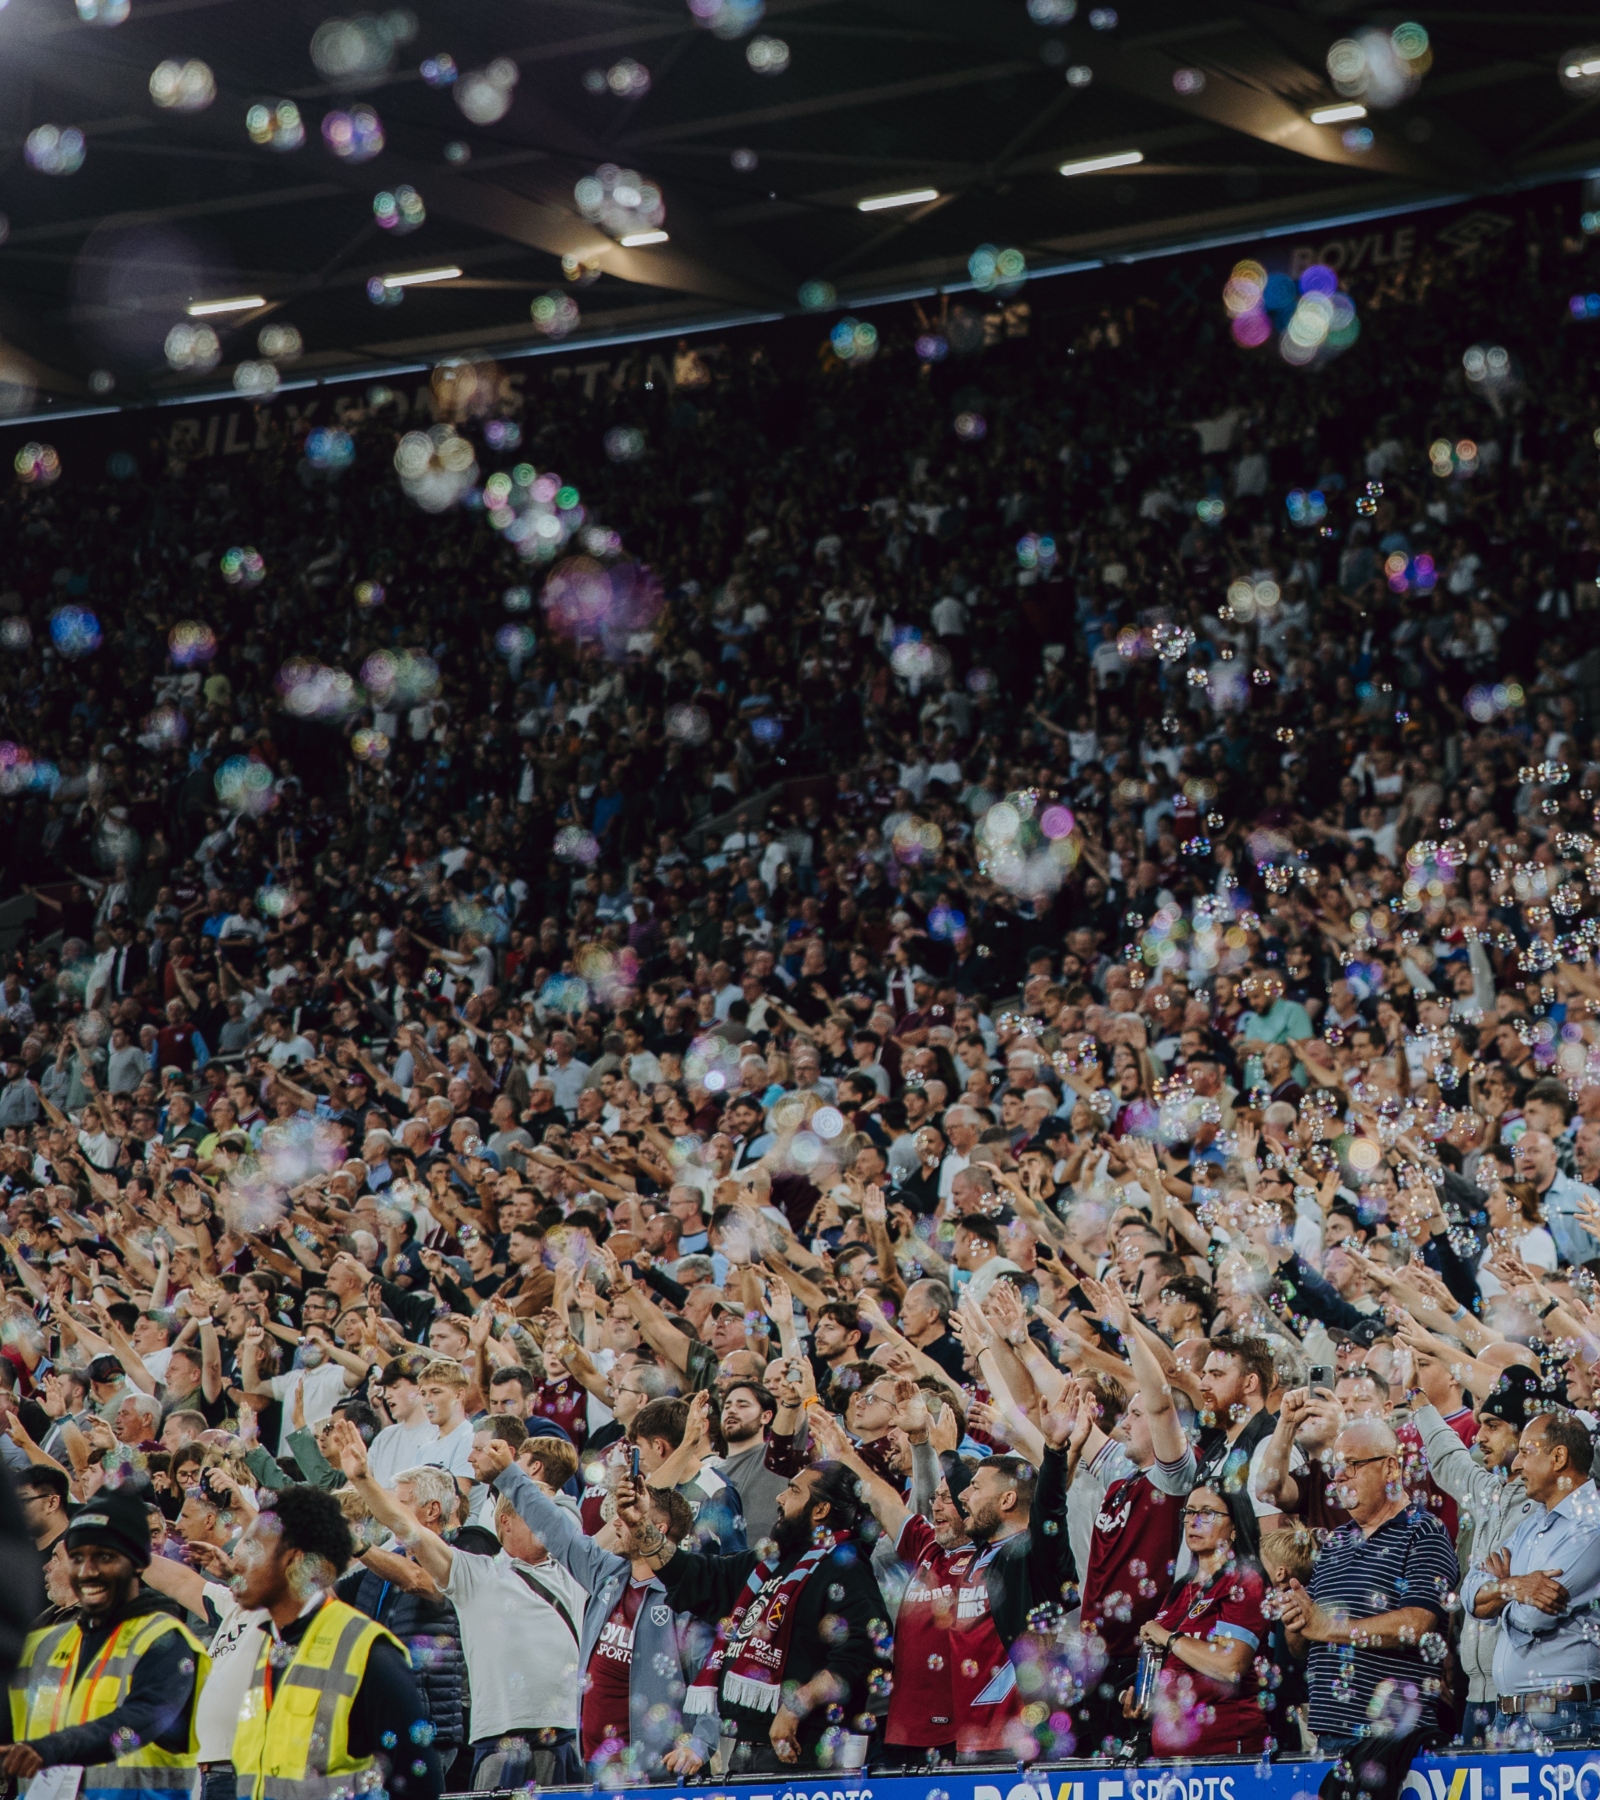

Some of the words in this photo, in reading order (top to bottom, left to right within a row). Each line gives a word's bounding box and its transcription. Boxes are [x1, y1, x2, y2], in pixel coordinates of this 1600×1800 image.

[749, 1637, 782, 1659] BOYLE
[754, 1649, 781, 1665] SPORTS
[1401, 1765, 1530, 1800] OYLE
